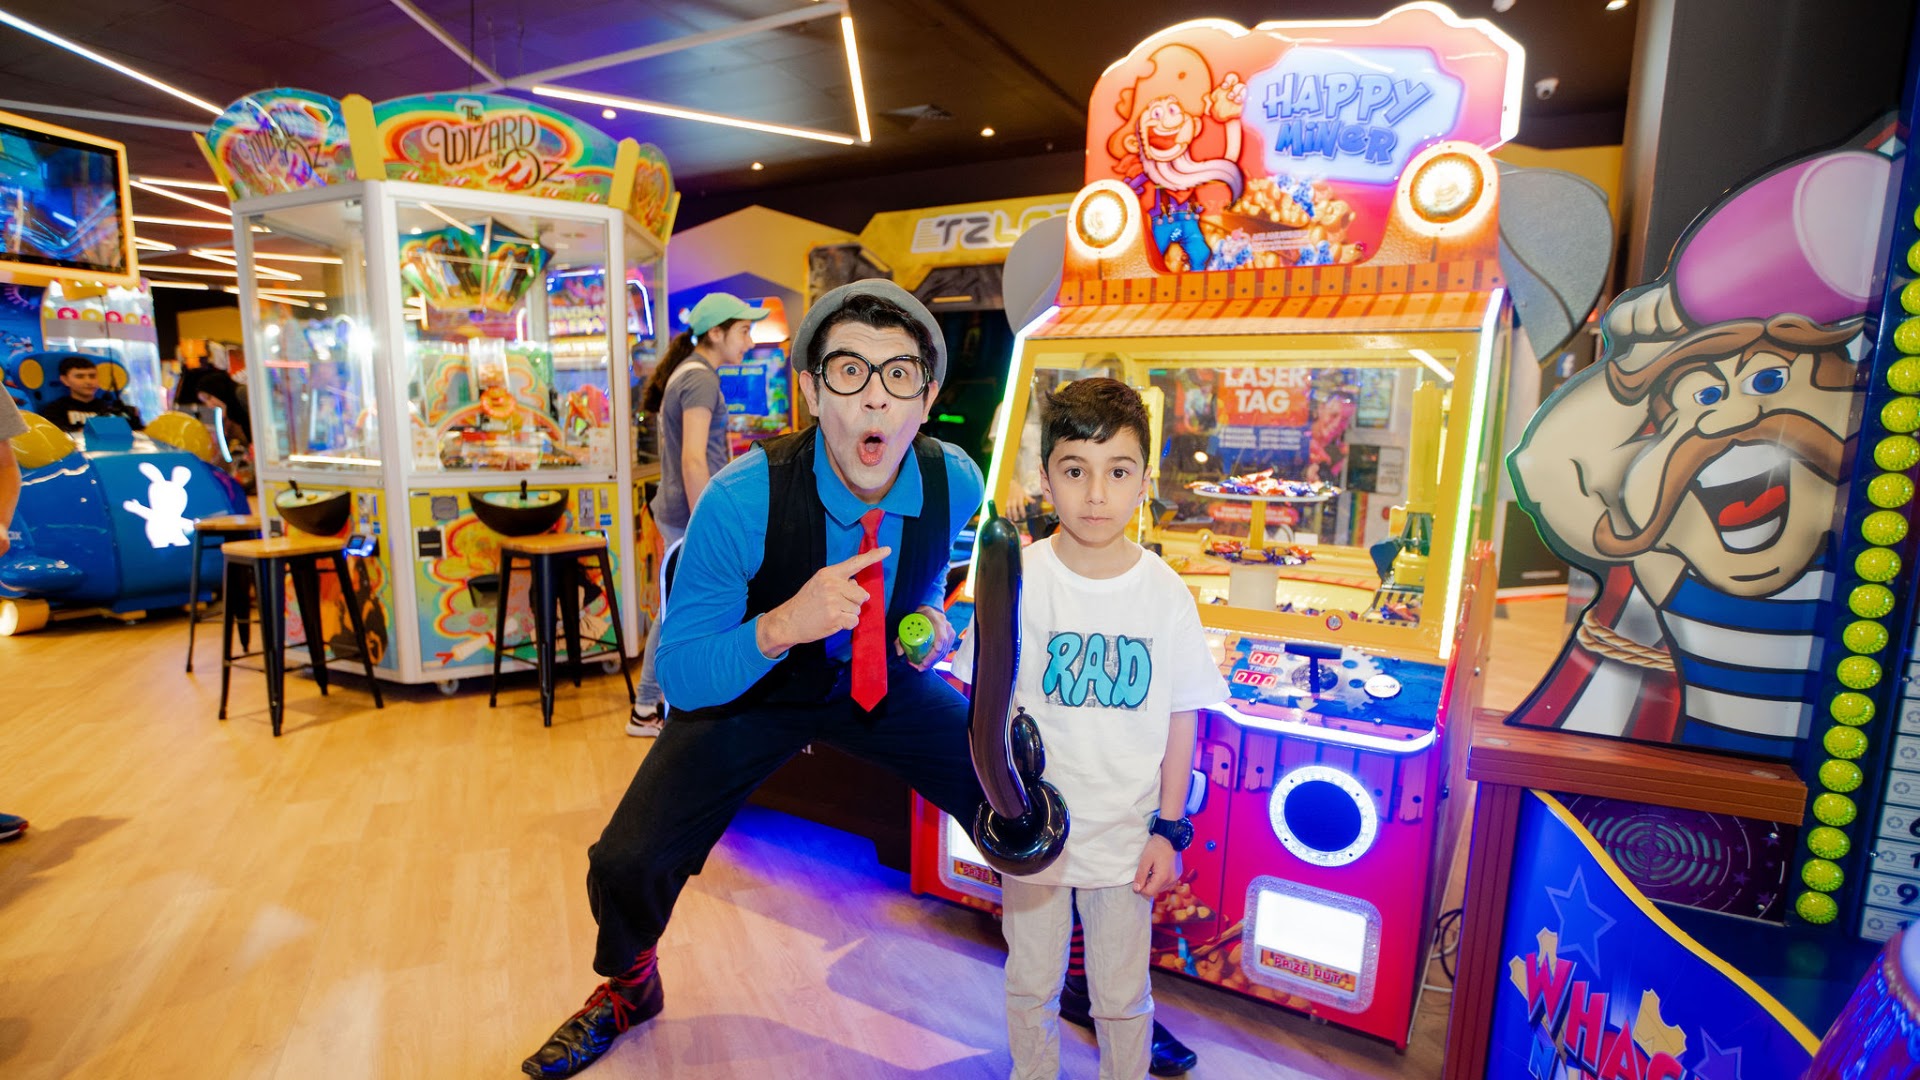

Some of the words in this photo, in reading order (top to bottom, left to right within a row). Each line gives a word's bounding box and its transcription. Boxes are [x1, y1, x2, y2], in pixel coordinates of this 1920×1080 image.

[1263, 73, 1432, 125] HAPPY
[427, 115, 537, 165] WIZARD
[1223, 367, 1306, 388] LASER
[1235, 389, 1290, 413] TAG
[1042, 632, 1152, 708] RAD
[1526, 952, 1700, 1080] WHAC
